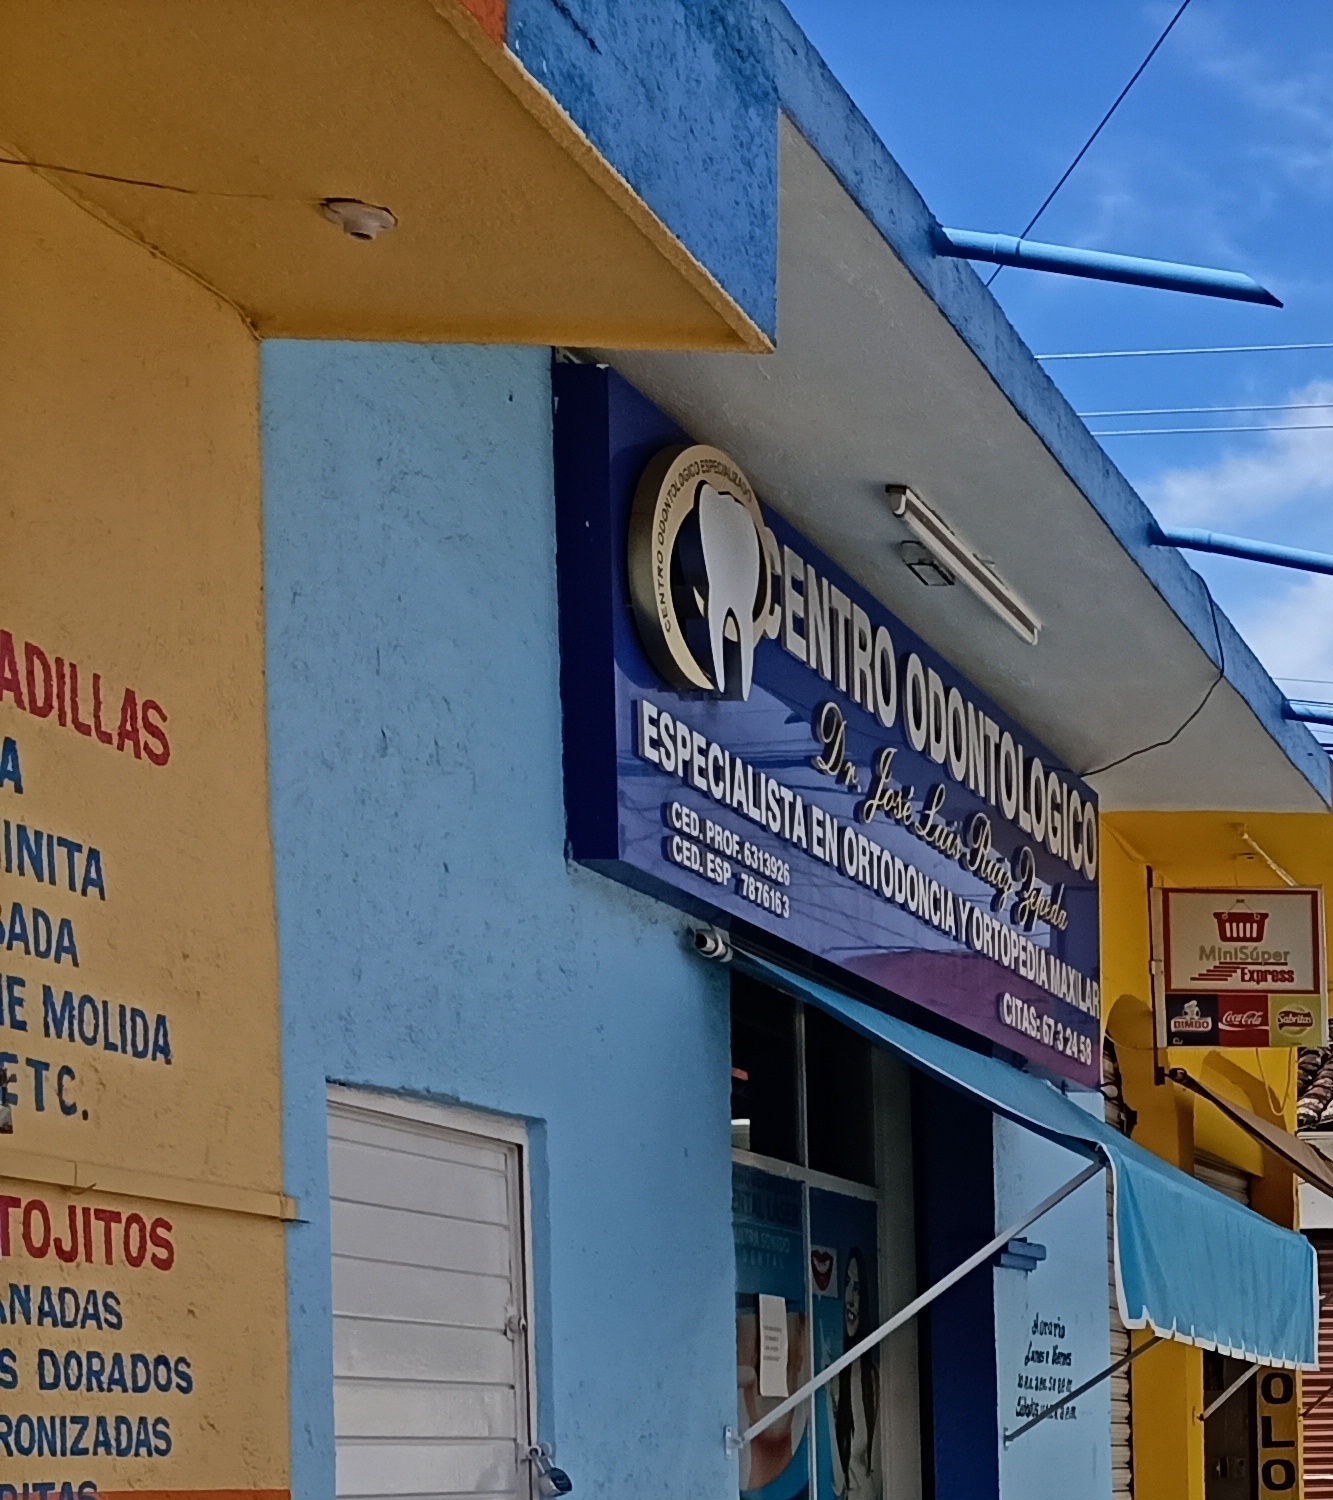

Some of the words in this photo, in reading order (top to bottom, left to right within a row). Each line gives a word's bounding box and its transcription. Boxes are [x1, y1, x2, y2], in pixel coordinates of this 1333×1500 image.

[656, 551, 671, 633] CENTRO
[0, 629, 170, 766] ADILLAS
[904, 653, 1098, 881] ODONTOLOGICO
[671, 801, 703, 840] CED.
[706, 819, 742, 861] PROF.
[743, 841, 790, 886] 6313926
[816, 702, 861, 793] Dr.
[862, 748, 914, 825] José
[966, 813, 1014, 912] Ruiz
[1017, 846, 1069, 932] Zepeda
[640, 700, 807, 849] ESPECIALISTA
[811, 804, 838, 867] EN
[842, 826, 956, 936] ORTODONCIA
[957, 897, 972, 943] Y
[971, 906, 1049, 990] ORTOPEDIA
[1050, 955, 1100, 1019] MAXILAR
[672, 835, 703, 873] CED.
[706, 852, 732, 885] ESP
[740, 873, 790, 919] 7876163
[0, 901, 80, 968] ADA
[1240, 966, 1295, 985] Express
[42, 984, 172, 1065] MOLIDA
[1003, 992, 1040, 1040] CITAS:
[1042, 1014, 1055, 1046] 67
[1056, 1022, 1064, 1051] 3
[1065, 1027, 1078, 1058] 24
[1080, 1034, 1092, 1066] 58
[0, 1052, 89, 1121] ETC.
[0, 1195, 175, 1271] TOJITOS
[0, 1283, 122, 1331] NADAS
[38, 1348, 193, 1395] DORADOS
